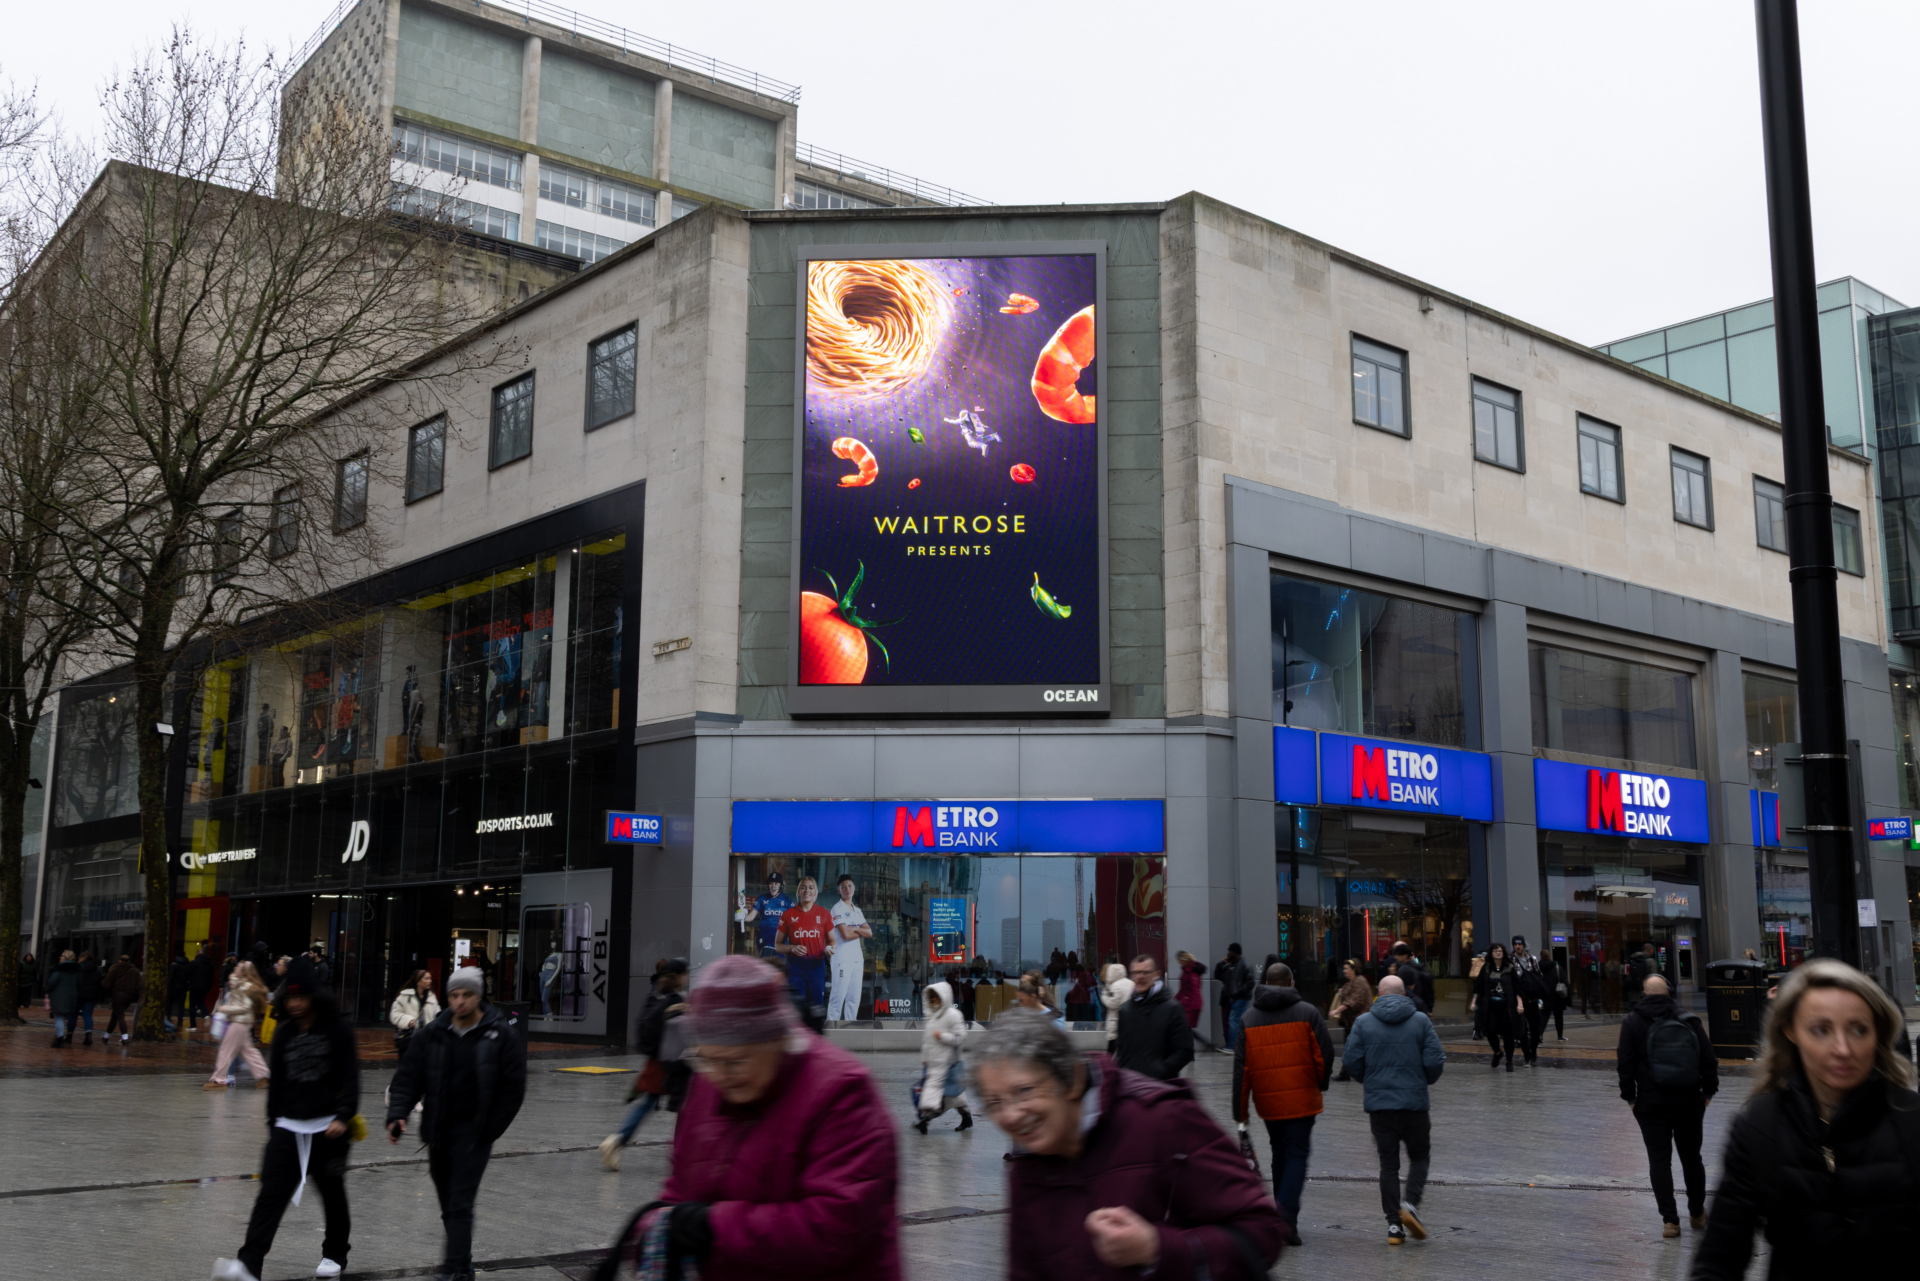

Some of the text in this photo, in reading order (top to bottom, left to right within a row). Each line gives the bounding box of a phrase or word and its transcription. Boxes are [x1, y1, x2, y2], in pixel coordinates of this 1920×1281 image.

[873, 514, 1026, 535] WAITROSE
[907, 545, 991, 556] PRESENTS
[1043, 689, 1098, 702] OCEAN
[1352, 744, 1438, 802] METRO
[1390, 782, 1440, 807] BANK
[1586, 769, 1671, 833] METRO
[475, 812, 553, 834] JDSPORTS.CO.UK
[612, 816, 659, 839] METRO
[892, 806, 999, 847] METRO
[1624, 810, 1673, 837] BANK
[1869, 820, 1908, 837] METRO
[1885, 828, 1908, 836] BANK
[341, 819, 371, 864] JD
[632, 830, 659, 840] BANK
[939, 831, 999, 847] BANK
[207, 852, 221, 864] KING
[228, 848, 257, 862] TRAINERS
[764, 908, 784, 917] cinch
[793, 926, 821, 939] cinch
[592, 918, 608, 1005] AYBL
[874, 998, 912, 1014] METRO
